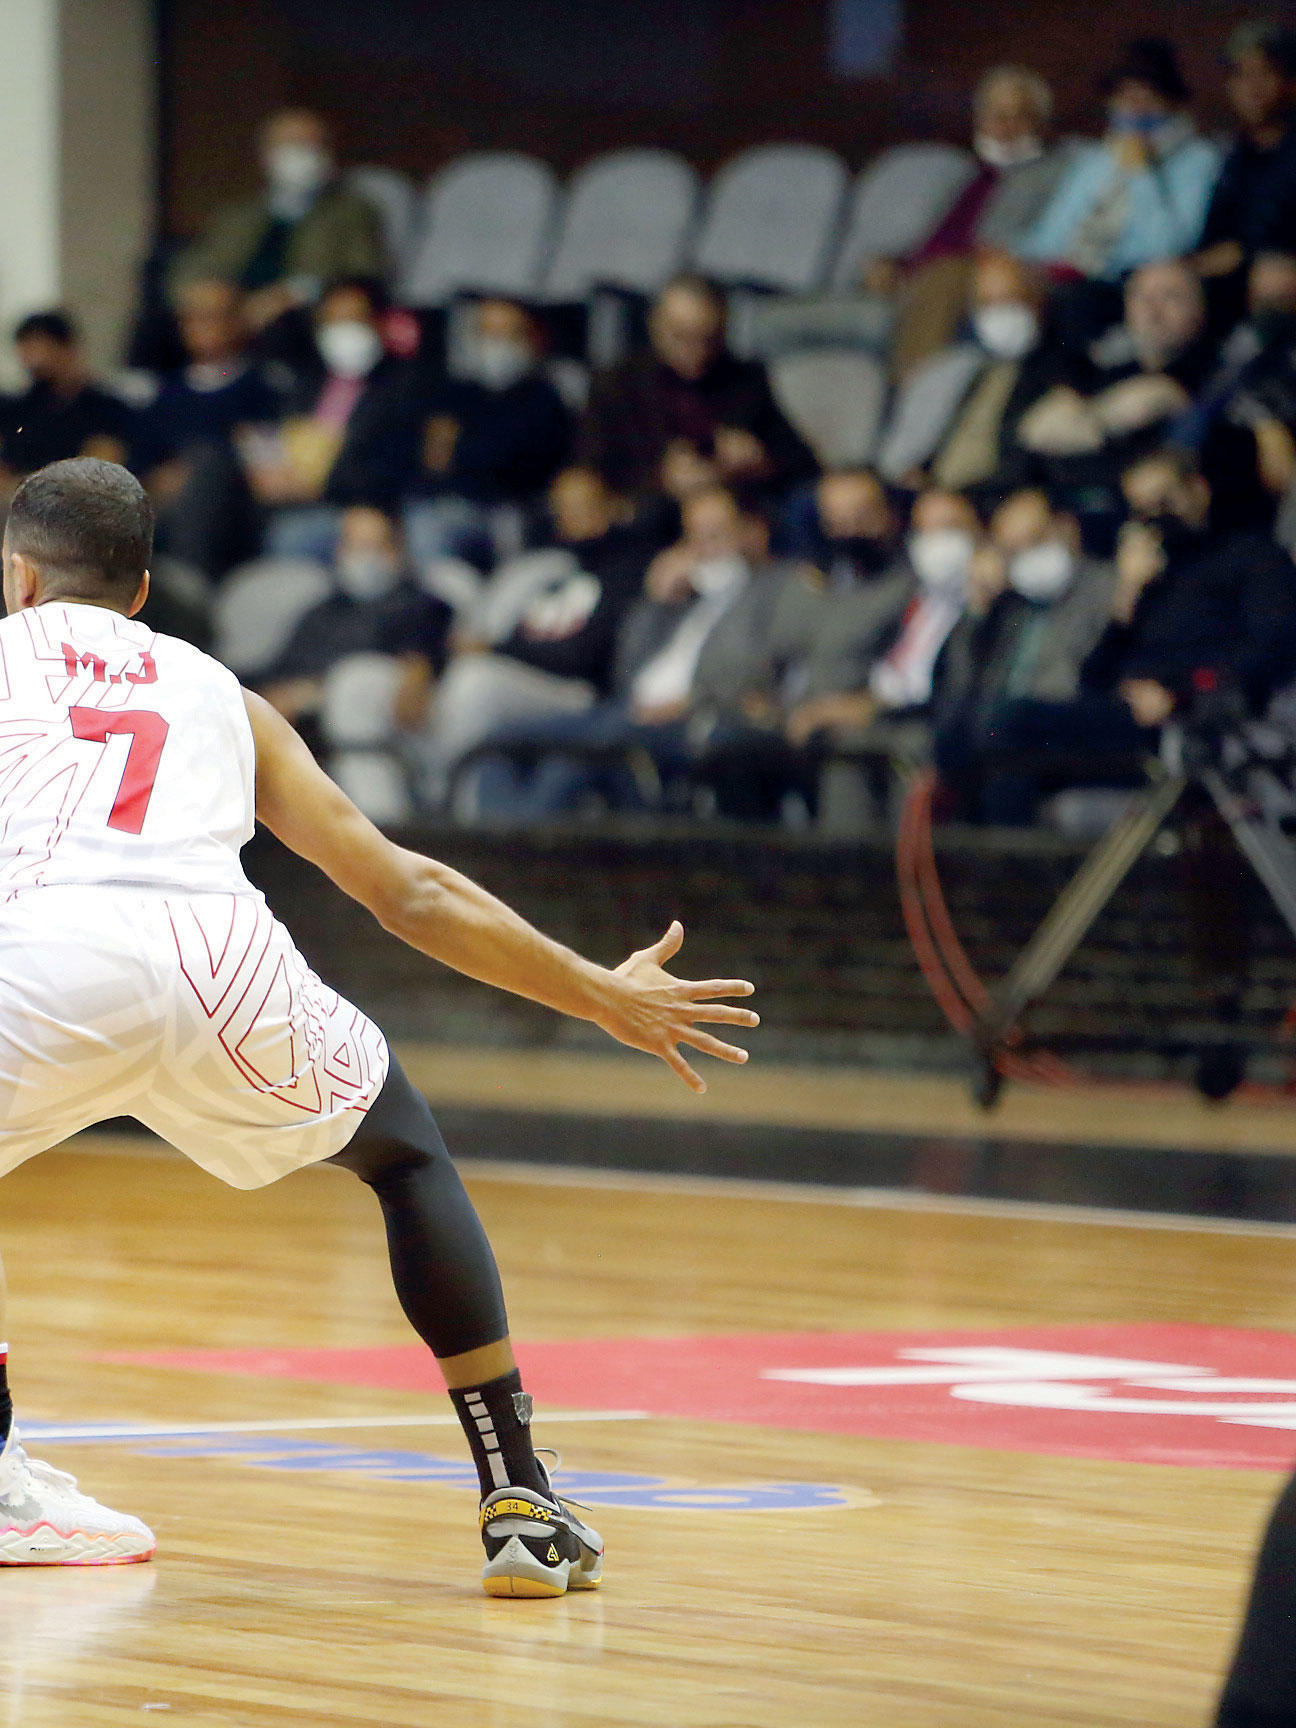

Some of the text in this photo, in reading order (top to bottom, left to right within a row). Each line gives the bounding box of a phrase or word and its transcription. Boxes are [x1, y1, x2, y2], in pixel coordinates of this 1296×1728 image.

[61, 642, 158, 684] M.J
[68, 706, 170, 835] 7
[506, 1502, 518, 1511] 34
